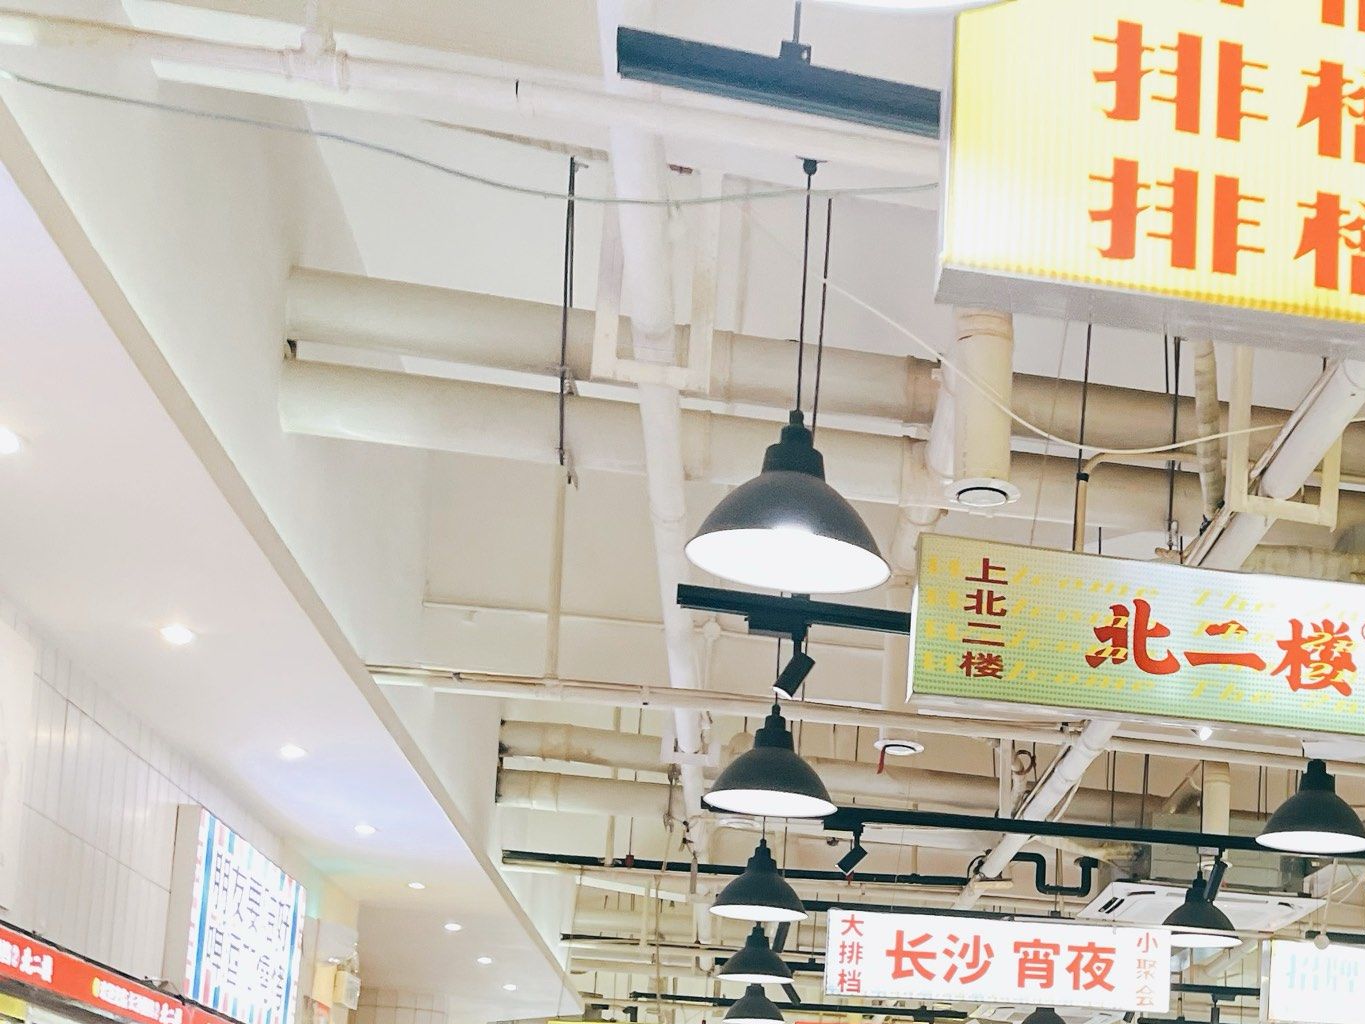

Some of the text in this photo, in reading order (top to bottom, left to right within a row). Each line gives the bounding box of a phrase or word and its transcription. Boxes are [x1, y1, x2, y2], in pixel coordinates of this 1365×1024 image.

[960, 557, 1009, 680] 上北二楼
[1085, 598, 1358, 697] 北二楼
[838, 914, 864, 993] 大排档
[885, 929, 1116, 993] 长沙 宵夜
[1135, 932, 1159, 1008] 小聚会
